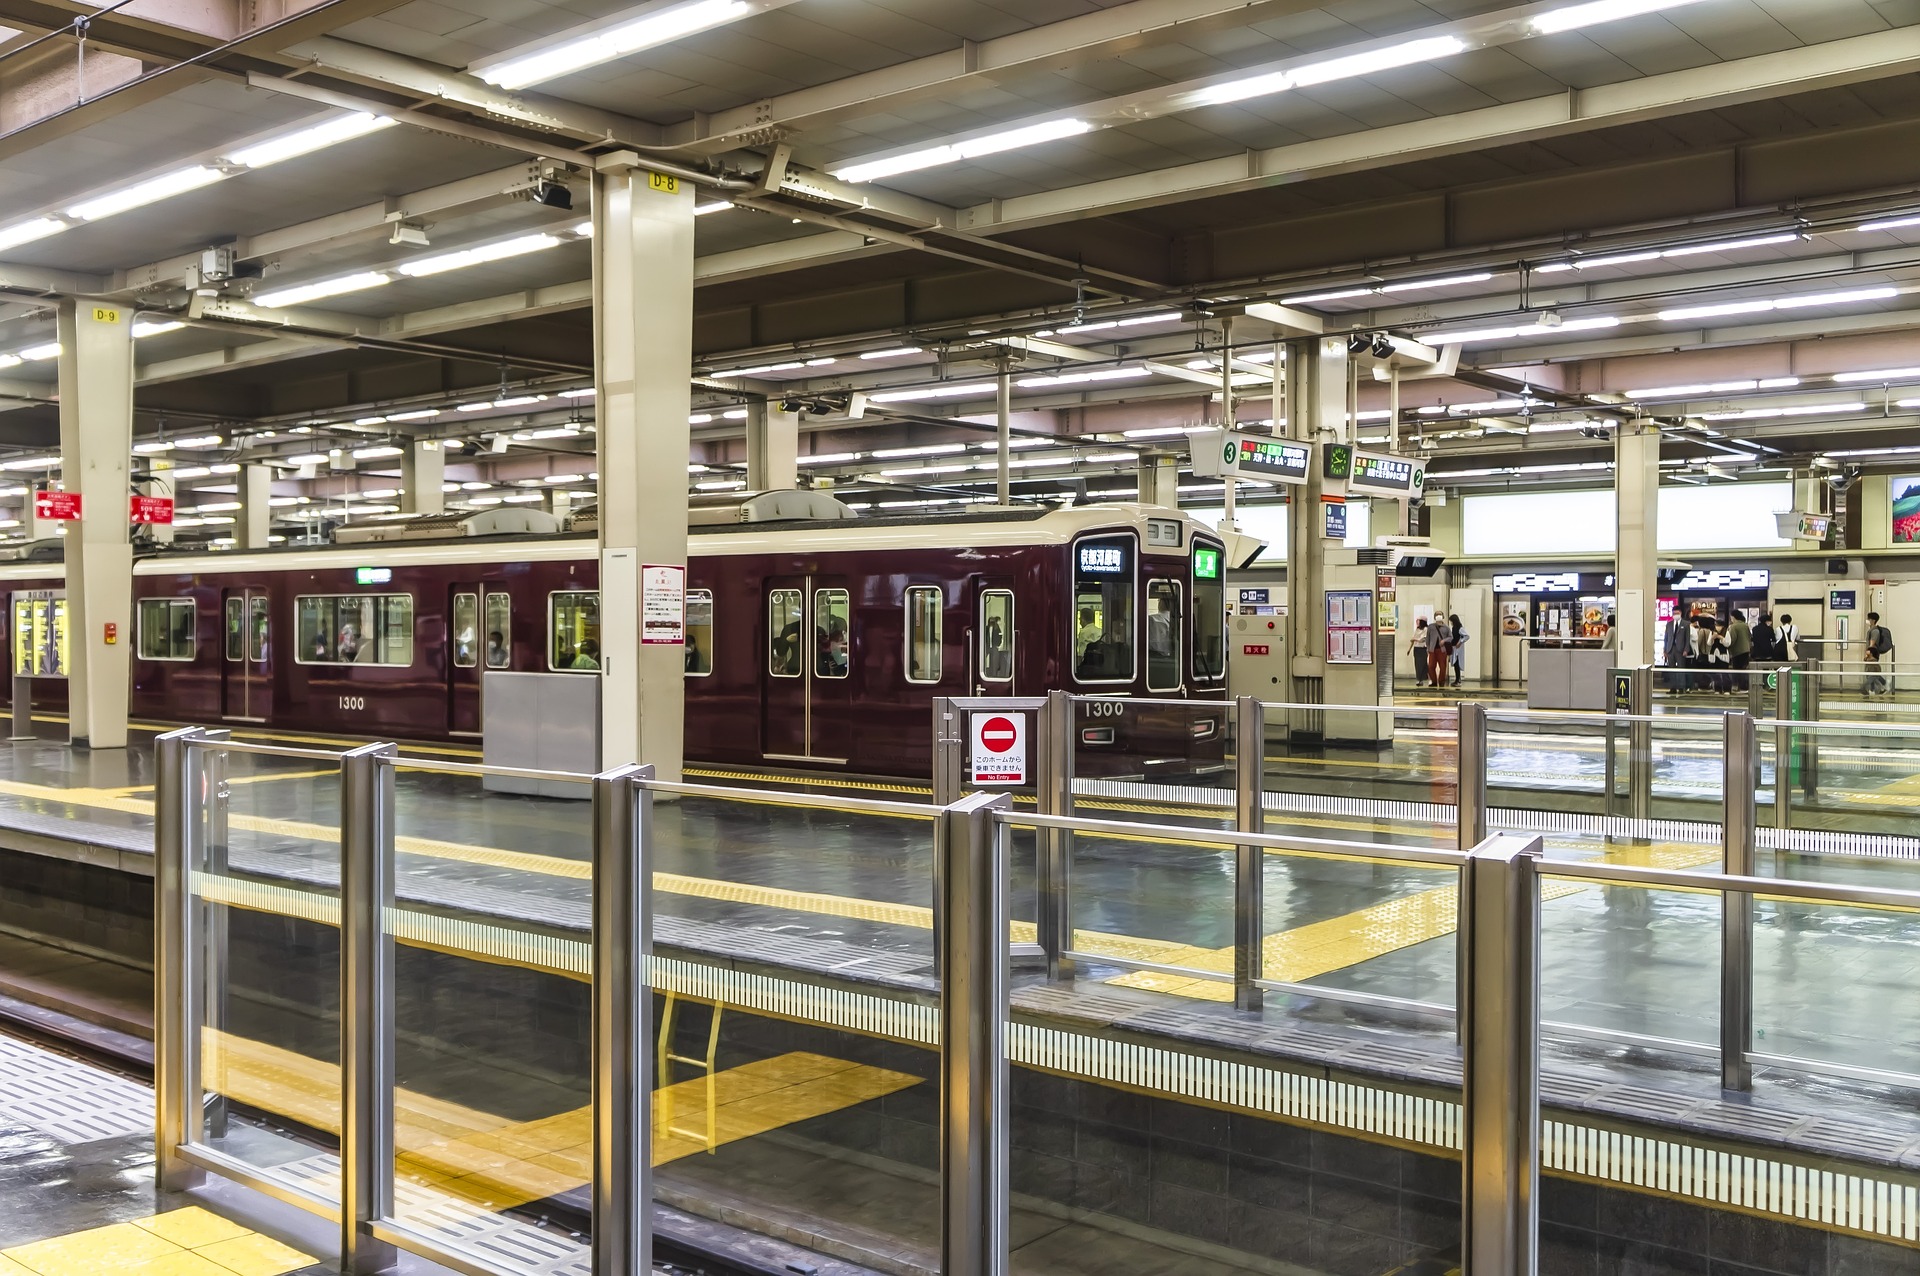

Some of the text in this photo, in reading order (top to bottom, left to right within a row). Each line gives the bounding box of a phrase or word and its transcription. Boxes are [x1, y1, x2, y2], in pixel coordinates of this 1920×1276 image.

[654, 173, 674, 191] D-8
[97, 309, 115, 322] D-9
[1081, 549, 1122, 566] 京都河原町
[339, 696, 364, 710] 1300
[1085, 702, 1124, 717] 1300
